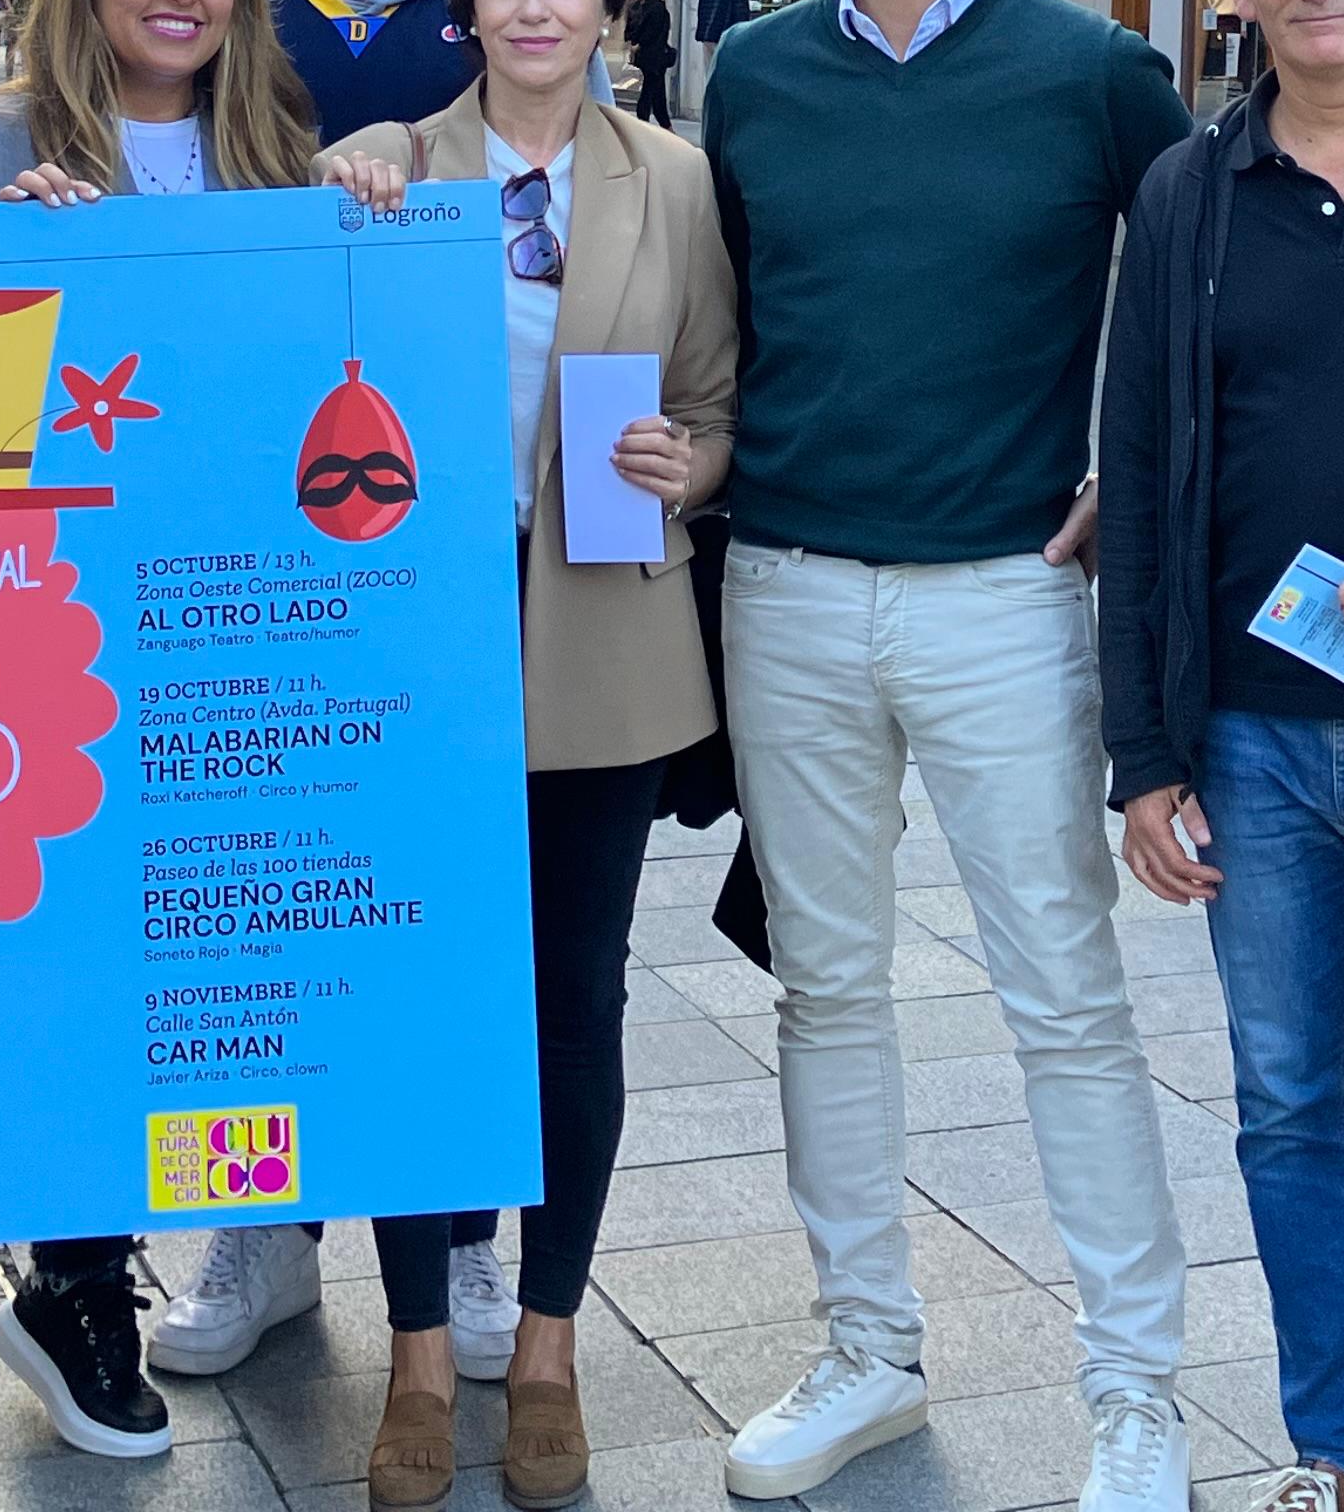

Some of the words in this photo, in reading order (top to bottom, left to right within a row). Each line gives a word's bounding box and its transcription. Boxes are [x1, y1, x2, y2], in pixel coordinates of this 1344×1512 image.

[350, 20, 367, 41] D
[372, 202, 461, 227] Logroño
[136, 563, 148, 579] 5
[152, 553, 256, 576] OCTUBRE
[261, 551, 269, 569] /
[275, 554, 295, 570] 13
[300, 550, 316, 567] h.
[136, 583, 184, 601] Zona
[189, 577, 243, 598] Oeste
[248, 571, 342, 595] Comercial
[346, 567, 417, 592] (ZOCO)
[137, 608, 174, 631] AL
[181, 603, 262, 629] OTRO
[270, 598, 348, 624] LADO
[137, 637, 206, 653] Zanguago
[211, 632, 254, 647] Teatro
[264, 627, 360, 644] Teatro/humor
[139, 686, 160, 703] 19
[165, 678, 270, 701] OCTUBRE
[275, 676, 283, 694] /
[288, 678, 305, 693] 11
[311, 674, 327, 691] h.
[139, 709, 186, 727] Zona
[192, 705, 256, 723] Centro
[261, 700, 319, 723] (Avda.
[324, 692, 411, 717] Portugal)
[140, 724, 331, 757] MALABARIAN
[339, 721, 382, 745] ON
[142, 759, 195, 783] THE
[204, 753, 286, 780] ROCK
[141, 791, 170, 805] Roxi
[174, 785, 248, 803] Katcheroff
[259, 783, 296, 798] Circo
[301, 784, 309, 797] y
[313, 780, 359, 794] humor
[143, 840, 166, 857] 26
[171, 831, 277, 855] OCTUBRE
[283, 830, 291, 847] /
[296, 832, 312, 846] 11
[318, 828, 334, 845] h.
[143, 863, 198, 881] Paseo
[203, 860, 225, 878] de
[231, 858, 257, 876] las
[263, 858, 297, 875] 100
[303, 851, 372, 870] tiendas
[144, 878, 283, 913] PEQUEÑO
[291, 876, 373, 903] GRAN
[144, 912, 237, 941] CIRCO
[245, 900, 423, 934] AMBULANTE
[144, 948, 195, 962] Soneto
[199, 946, 230, 962] Rojo
[240, 942, 283, 958] Magia
[145, 994, 157, 1011] 9
[163, 981, 296, 1007] NOVIEMBRE
[302, 979, 311, 998] /
[316, 981, 333, 996] 11
[339, 978, 354, 995] h.
[145, 1013, 194, 1033] Calle
[199, 1011, 235, 1031] San
[240, 1006, 299, 1028] Antón
[147, 1038, 207, 1065] CAR
[216, 1034, 283, 1061] MAN
[147, 1072, 190, 1086] Javier
[194, 1068, 230, 1082] Ariza
[240, 1064, 282, 1080] Circo,
[286, 1062, 328, 1075] clown
[167, 1118, 199, 1134] CUL
[156, 1136, 200, 1152] TURA
[160, 1156, 175, 1168] DE
[178, 1153, 200, 1169] CO
[165, 1170, 200, 1187] MER
[174, 1188, 201, 1203] CIO
